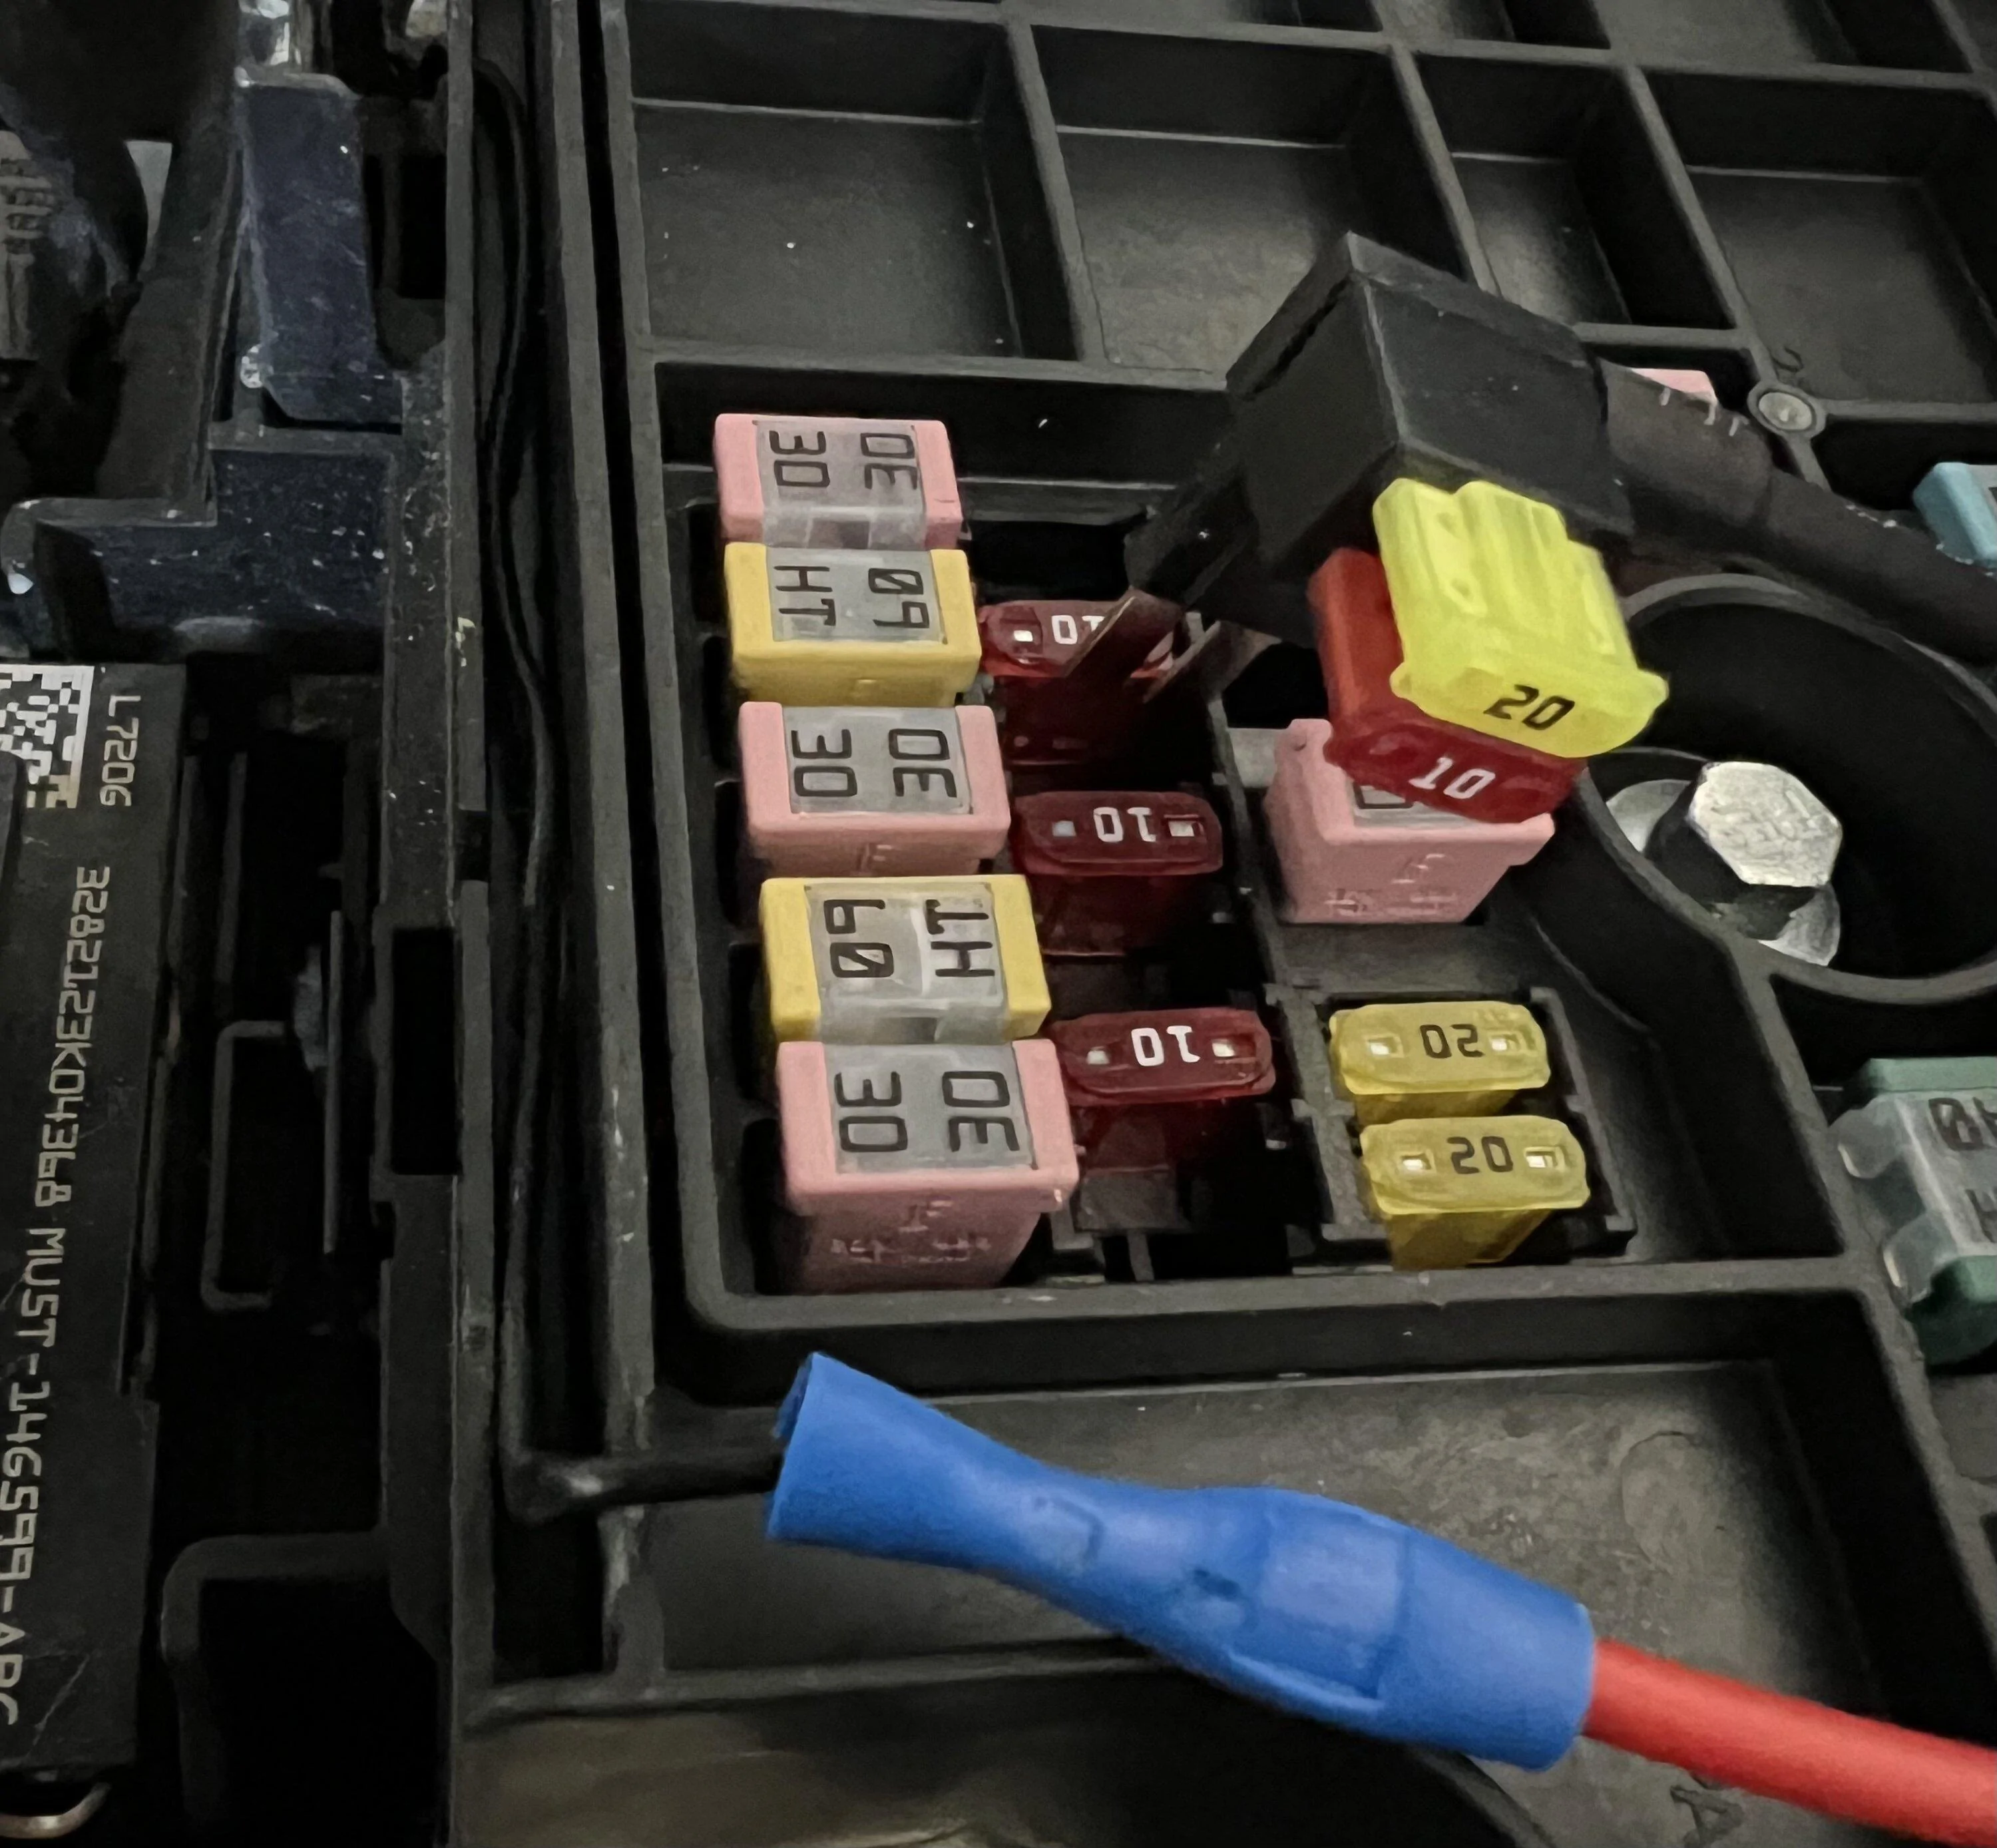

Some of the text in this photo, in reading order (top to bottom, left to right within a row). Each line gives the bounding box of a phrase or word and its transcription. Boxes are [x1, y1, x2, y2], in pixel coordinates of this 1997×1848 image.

[770, 431, 830, 488] 30
[860, 433, 918, 489] 30
[1483, 685, 1575, 730] 20
[791, 729, 857, 798] 30
[888, 729, 957, 798] 30
[1409, 757, 1495, 799] 10
[1094, 807, 1156, 842] 10
[1132, 1026, 1200, 1066] 10
[1420, 1024, 1484, 1058] 20
[835, 1072, 908, 1152] 30
[942, 1068, 1021, 1152] 30
[1447, 1136, 1513, 1174] 20
